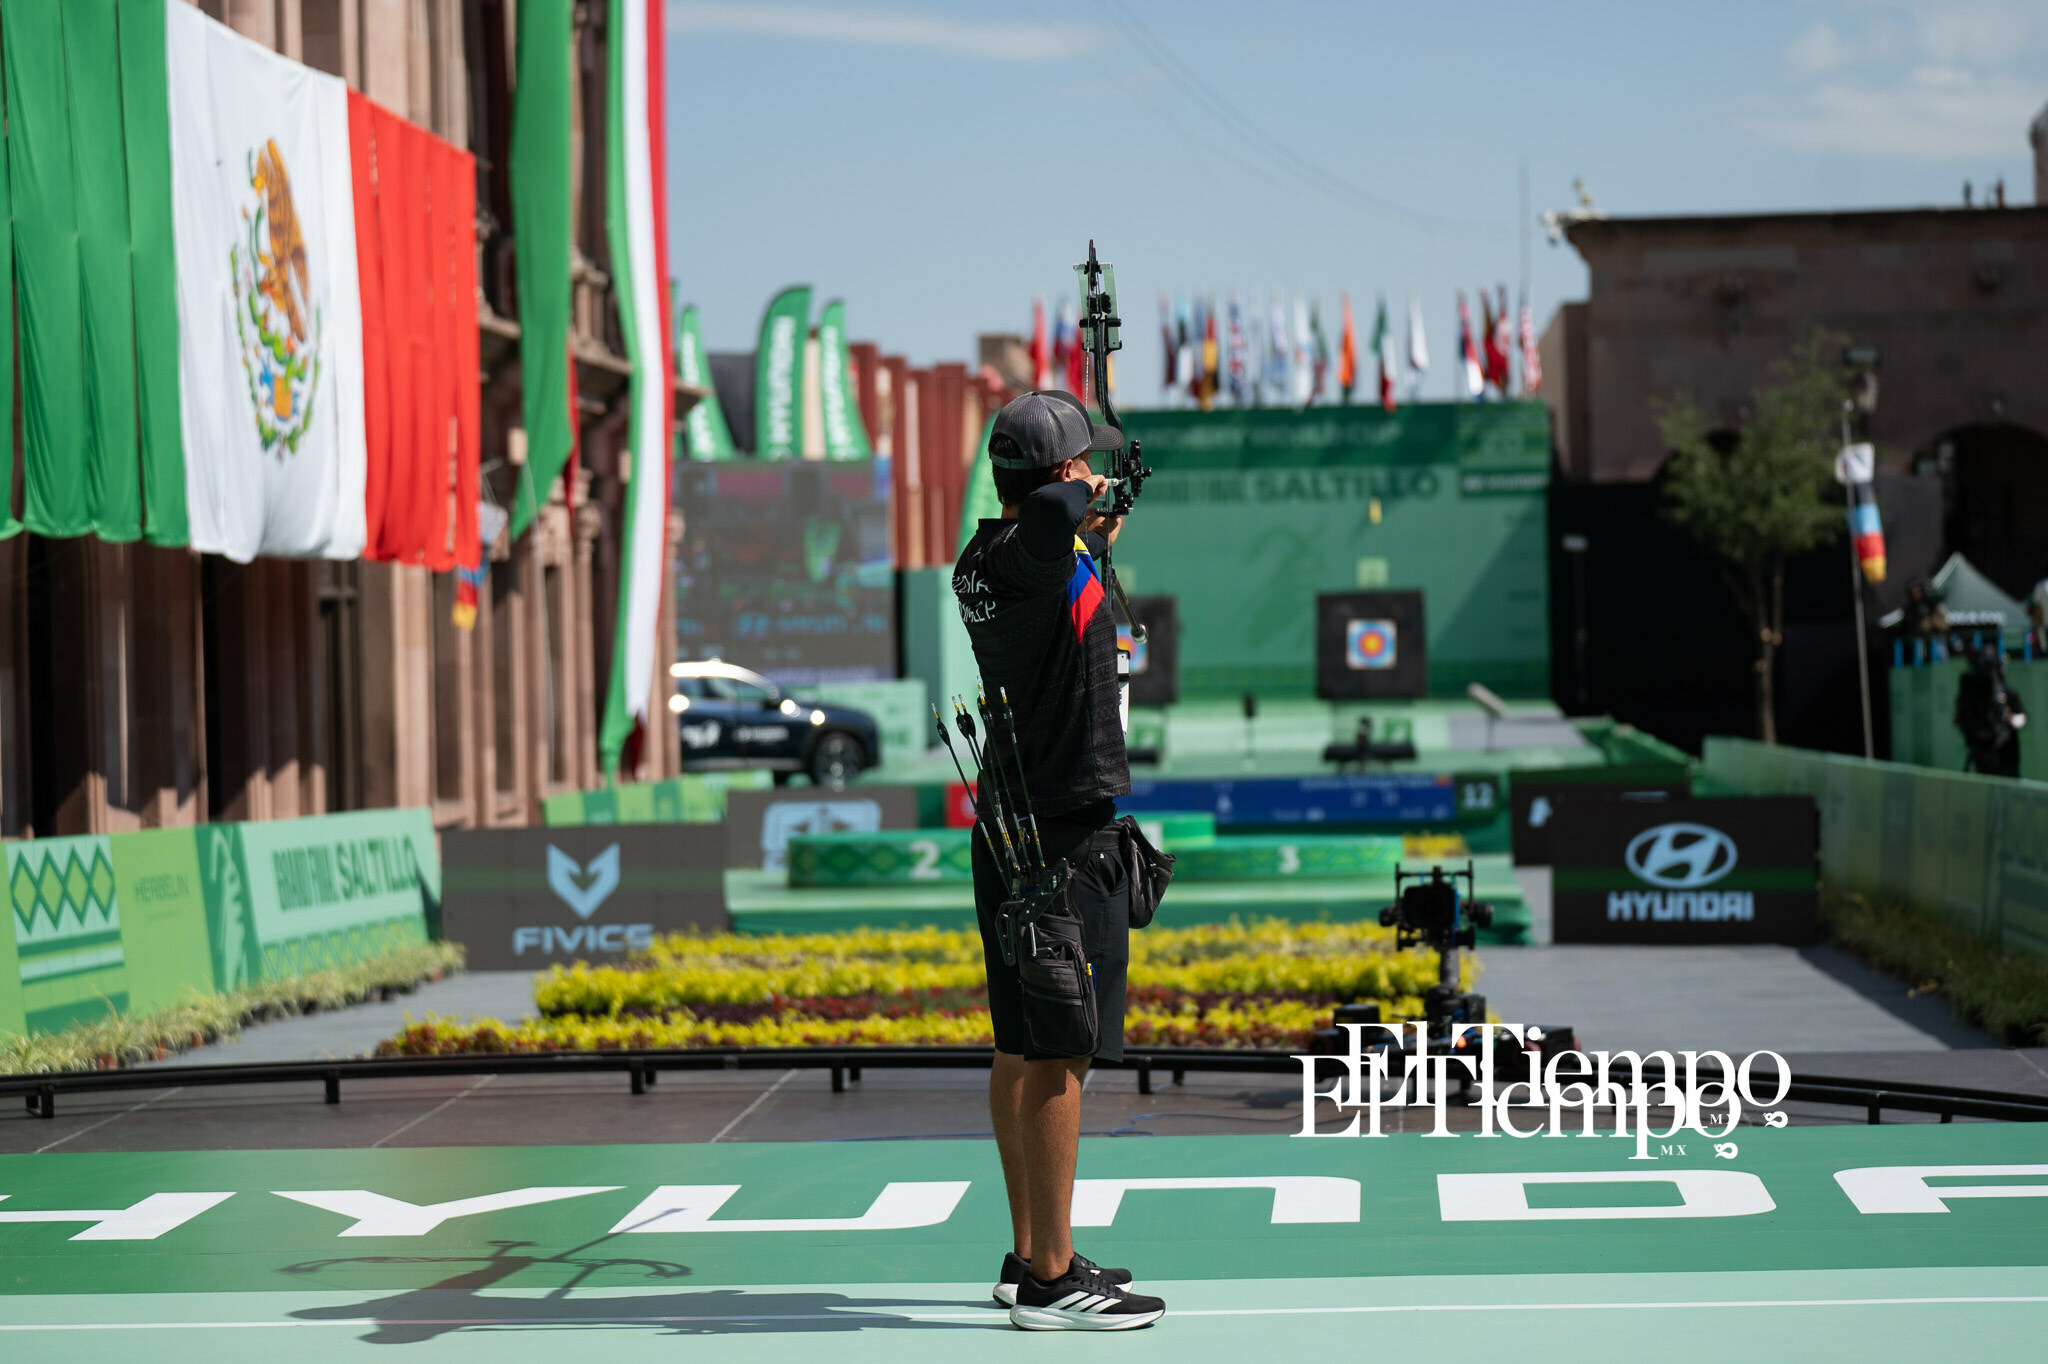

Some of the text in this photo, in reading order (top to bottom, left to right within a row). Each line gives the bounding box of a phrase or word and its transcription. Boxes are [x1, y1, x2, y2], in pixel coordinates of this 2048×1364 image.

[1253, 466, 1440, 501] SALTILLO
[1462, 782, 1495, 810] 12
[335, 833, 421, 902] SALTILLO
[908, 838, 942, 880] 2
[1277, 845, 1301, 874] 3
[1607, 891, 1756, 923] HYUNDAI
[512, 923, 655, 956] FIVICS
